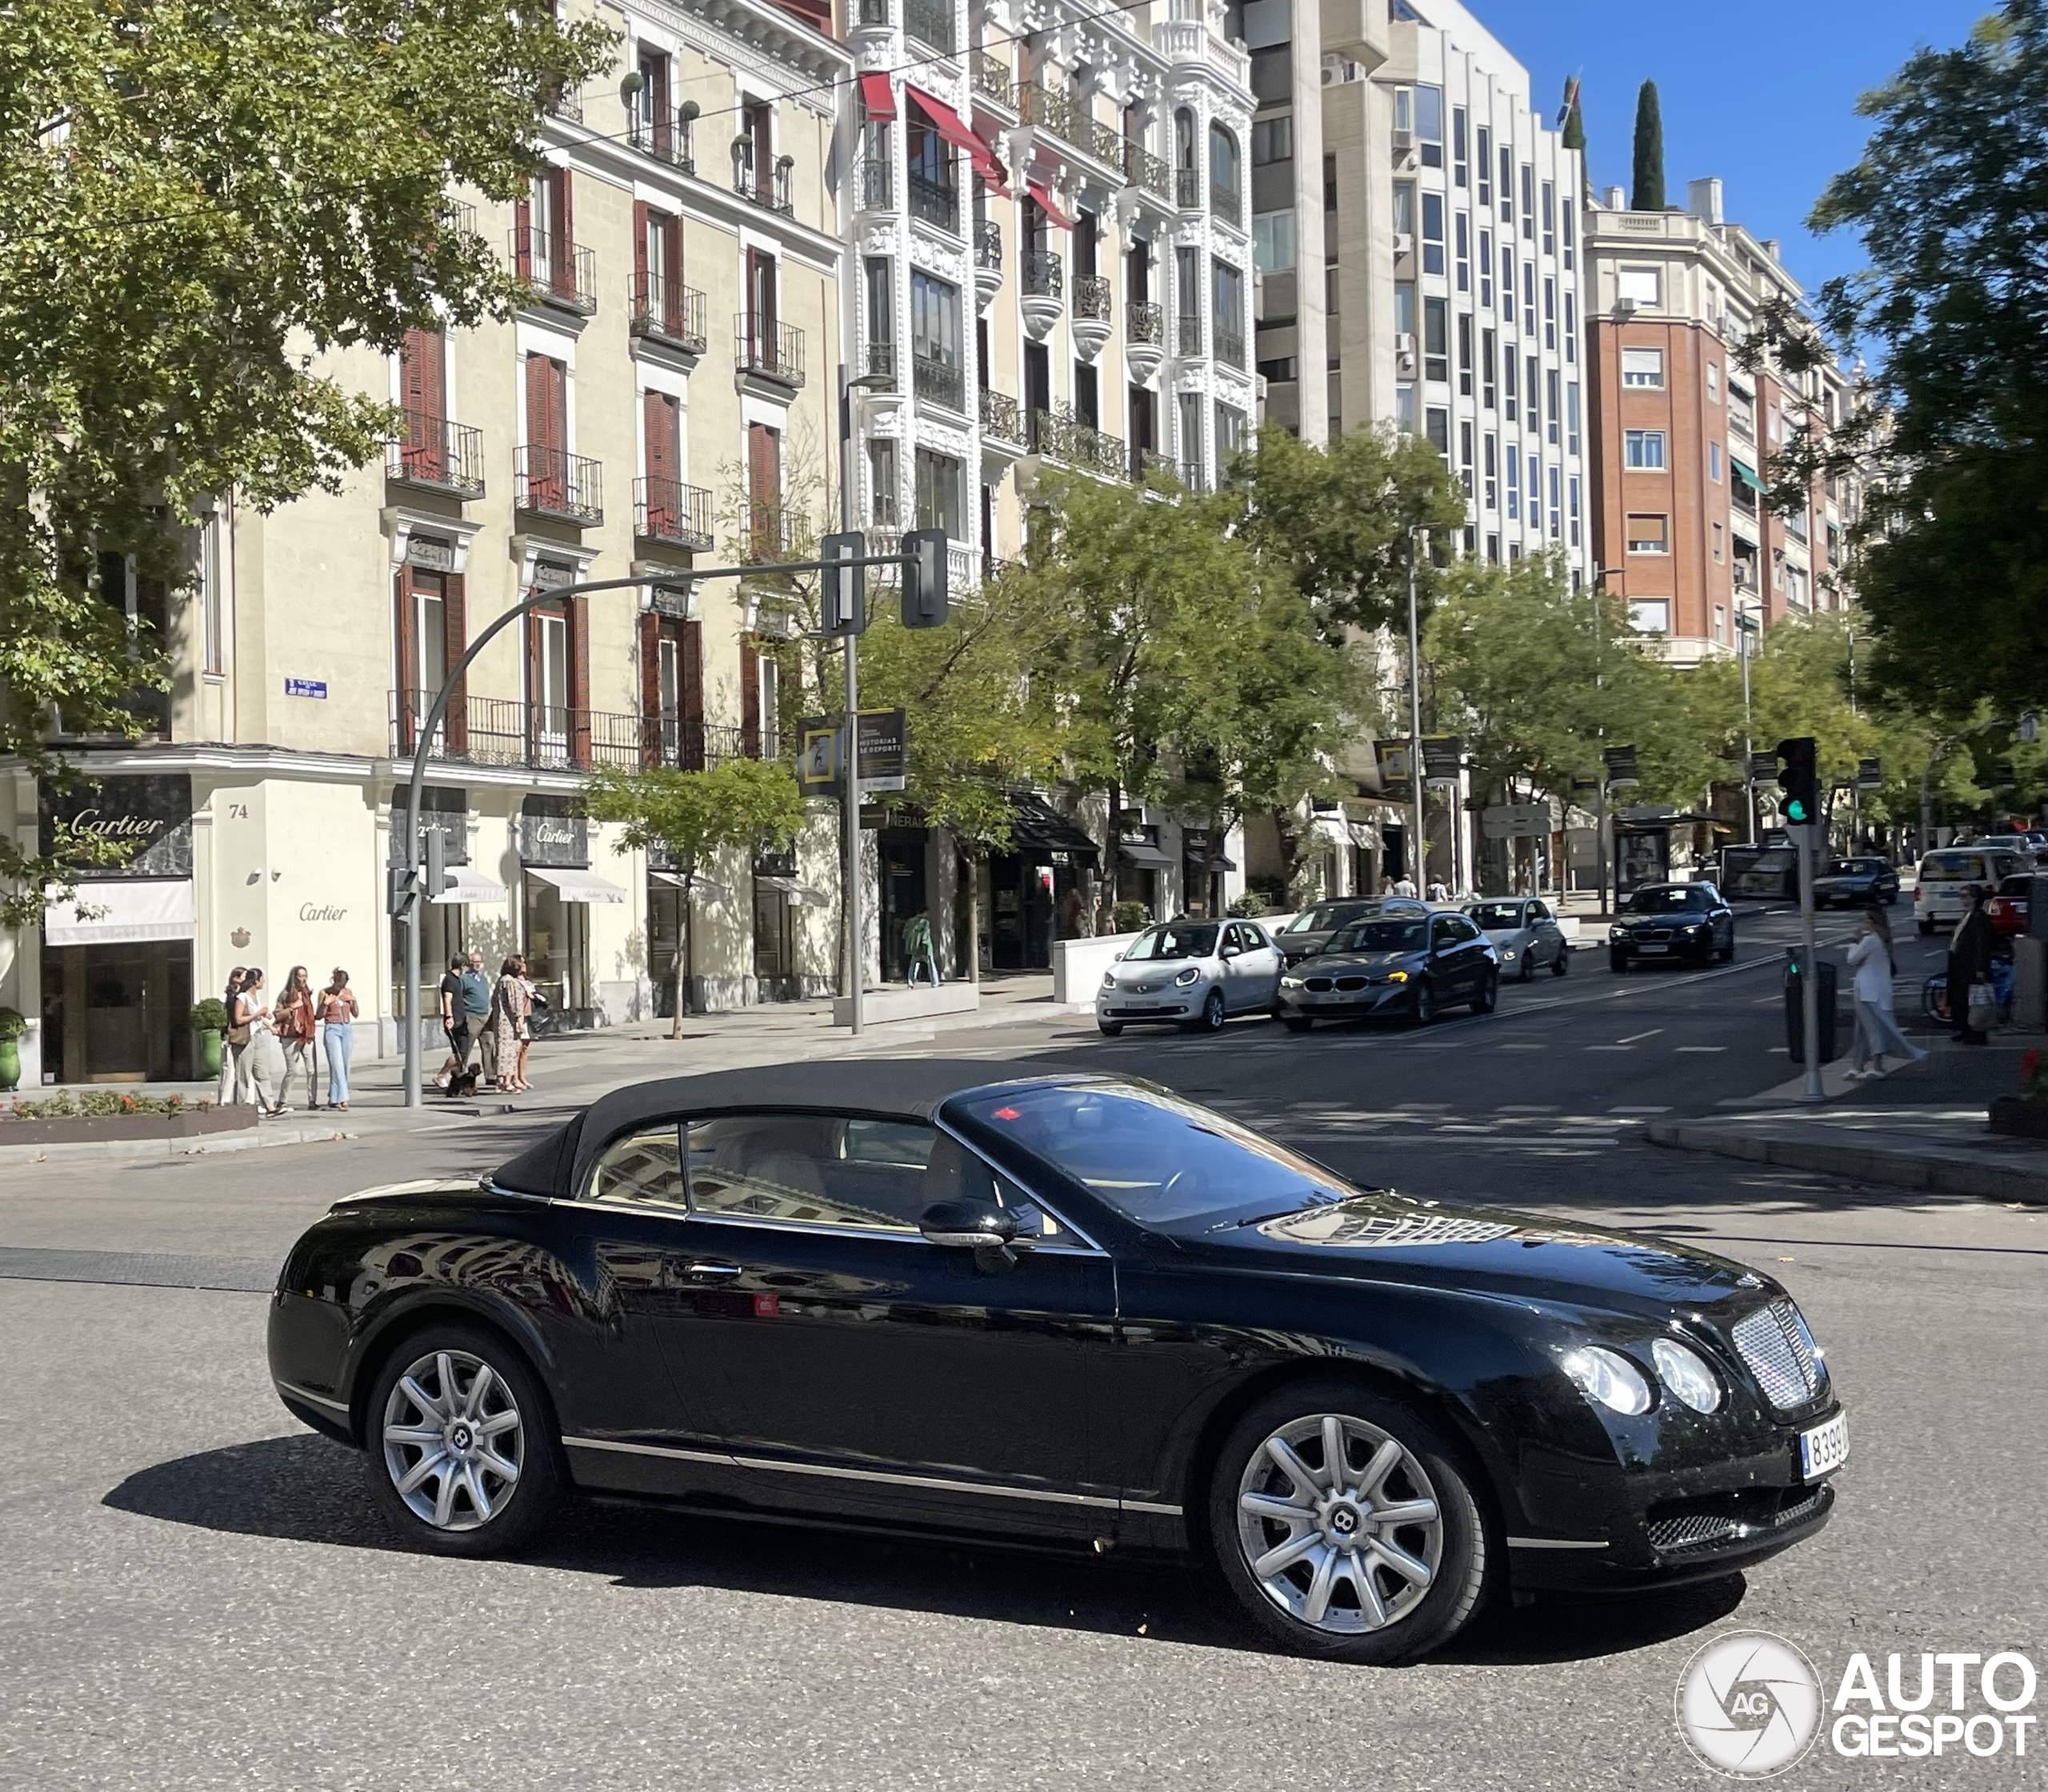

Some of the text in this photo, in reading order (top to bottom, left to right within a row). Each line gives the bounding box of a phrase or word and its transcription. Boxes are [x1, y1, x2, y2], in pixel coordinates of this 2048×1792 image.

[229, 804, 248, 819] 74
[70, 809, 164, 836] Cartier
[537, 822, 574, 844] Cartier
[299, 902, 347, 922] Cartier
